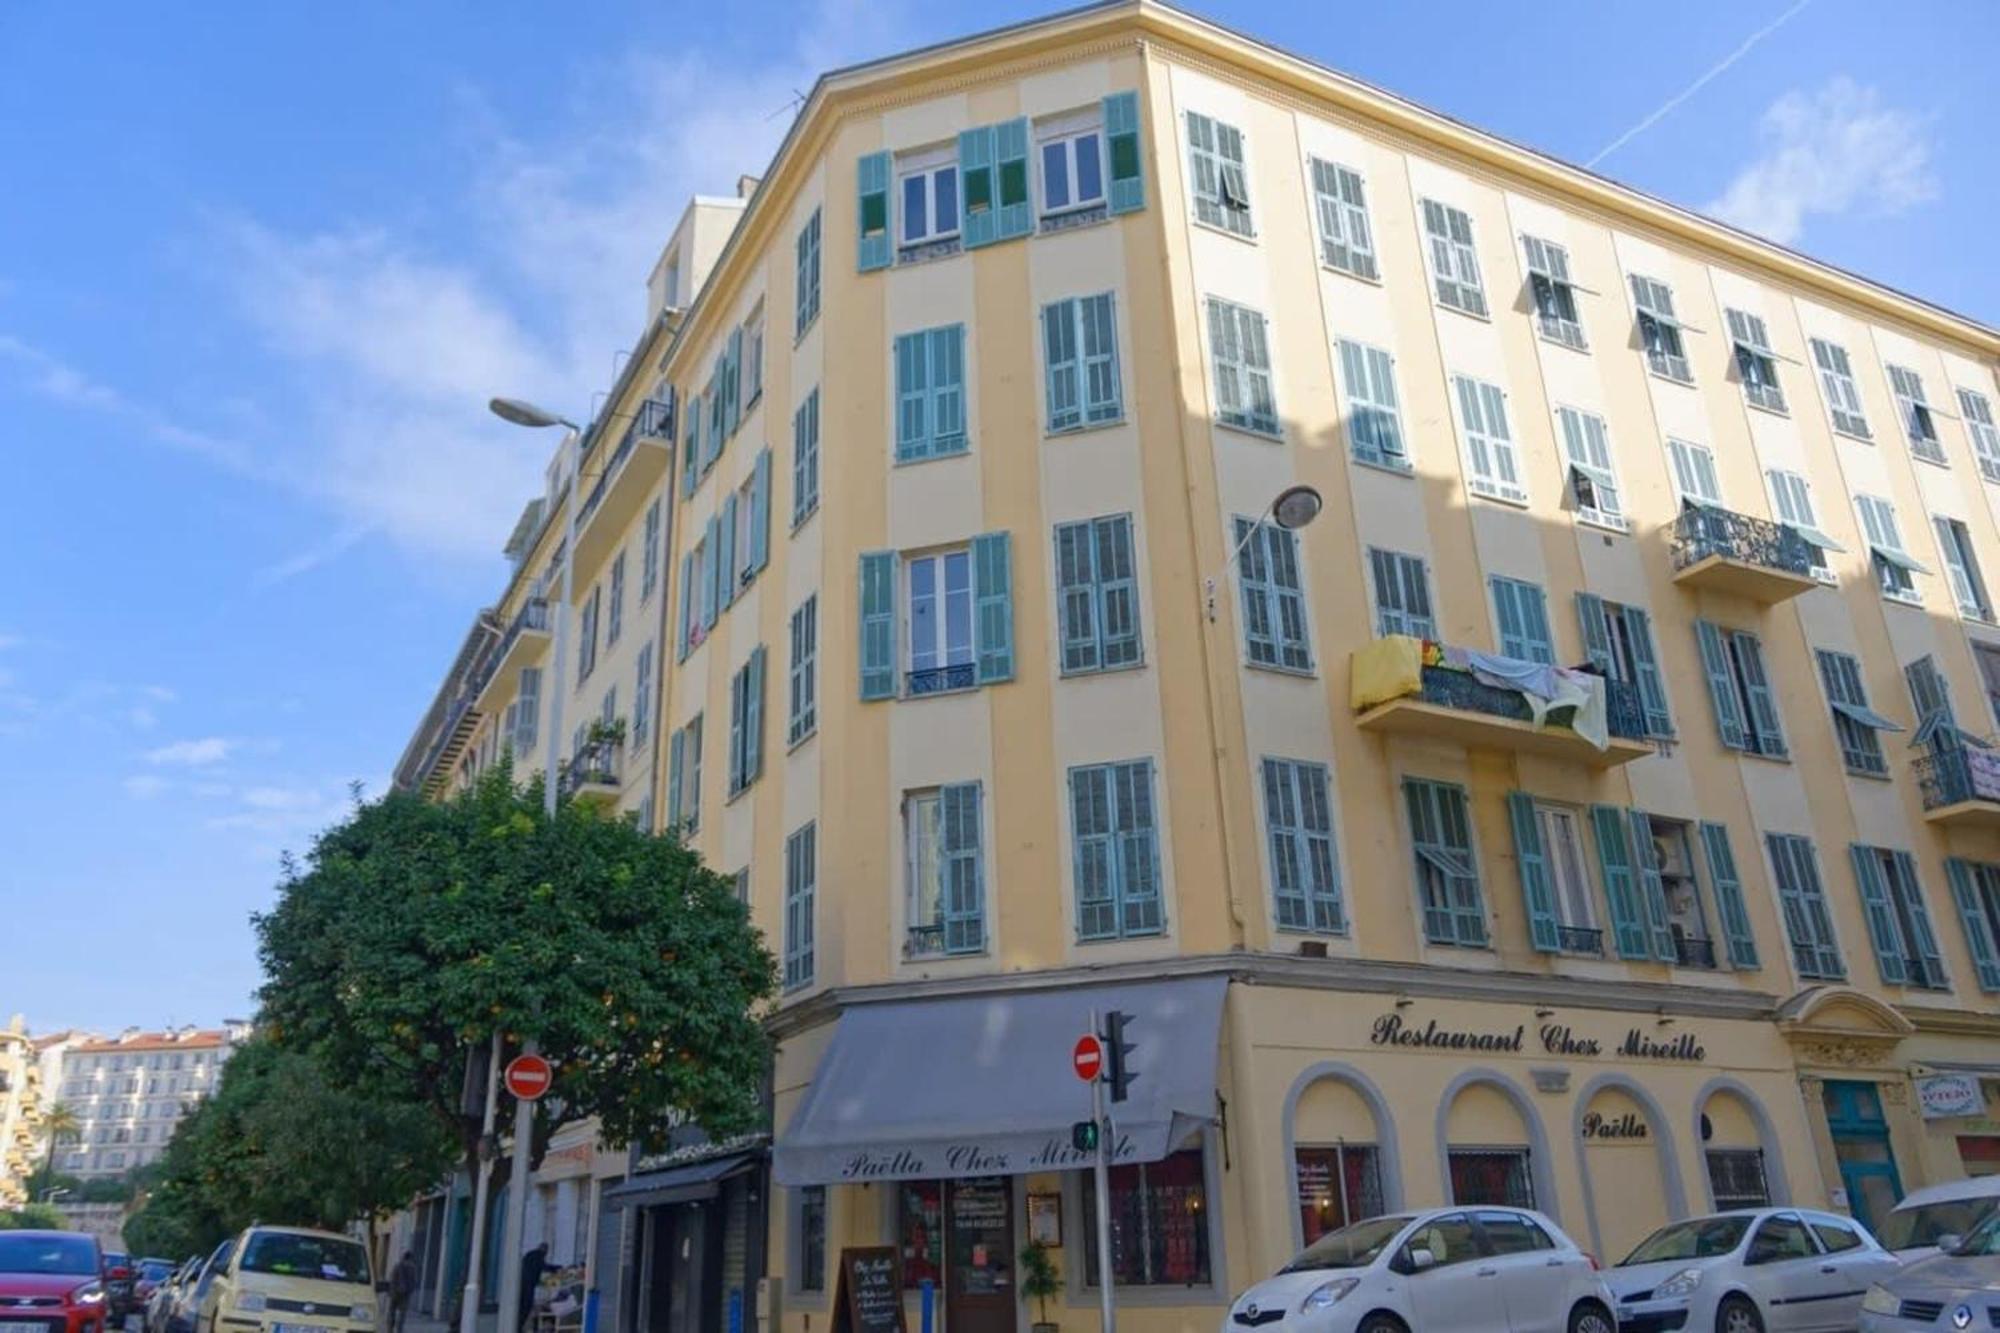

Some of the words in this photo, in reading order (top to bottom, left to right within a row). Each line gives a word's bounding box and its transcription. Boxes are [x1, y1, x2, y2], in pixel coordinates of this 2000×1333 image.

[1371, 1013, 1524, 1052] Restaurant
[1540, 1024, 1602, 1056] Chez
[1616, 1028, 1706, 1061] Mireille
[945, 1145, 1008, 1172] Chez
